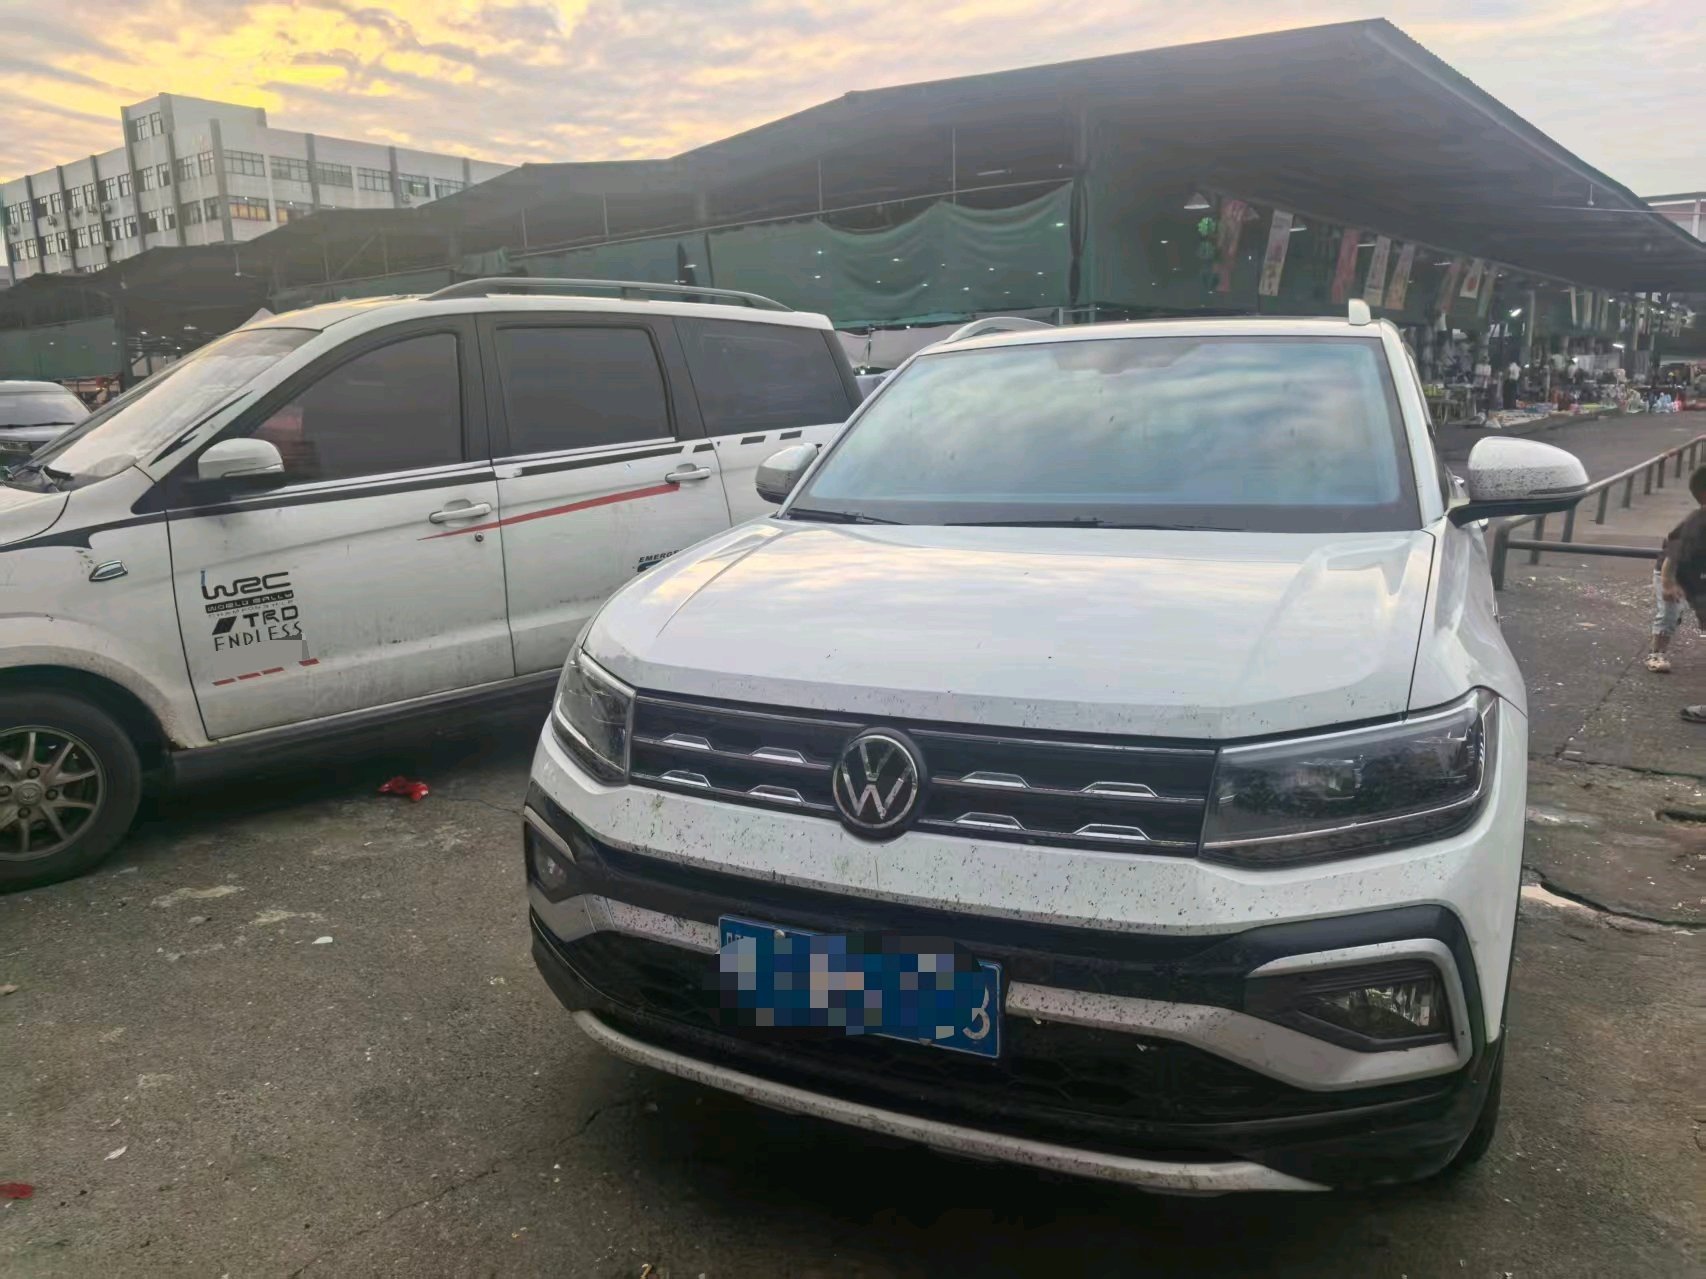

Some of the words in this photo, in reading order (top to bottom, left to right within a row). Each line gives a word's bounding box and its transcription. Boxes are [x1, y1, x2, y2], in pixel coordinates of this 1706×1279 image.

[201, 570, 291, 600] WRC
[207, 600, 249, 612] WORLD
[252, 592, 291, 604] RALLY
[243, 605, 299, 627] TRD
